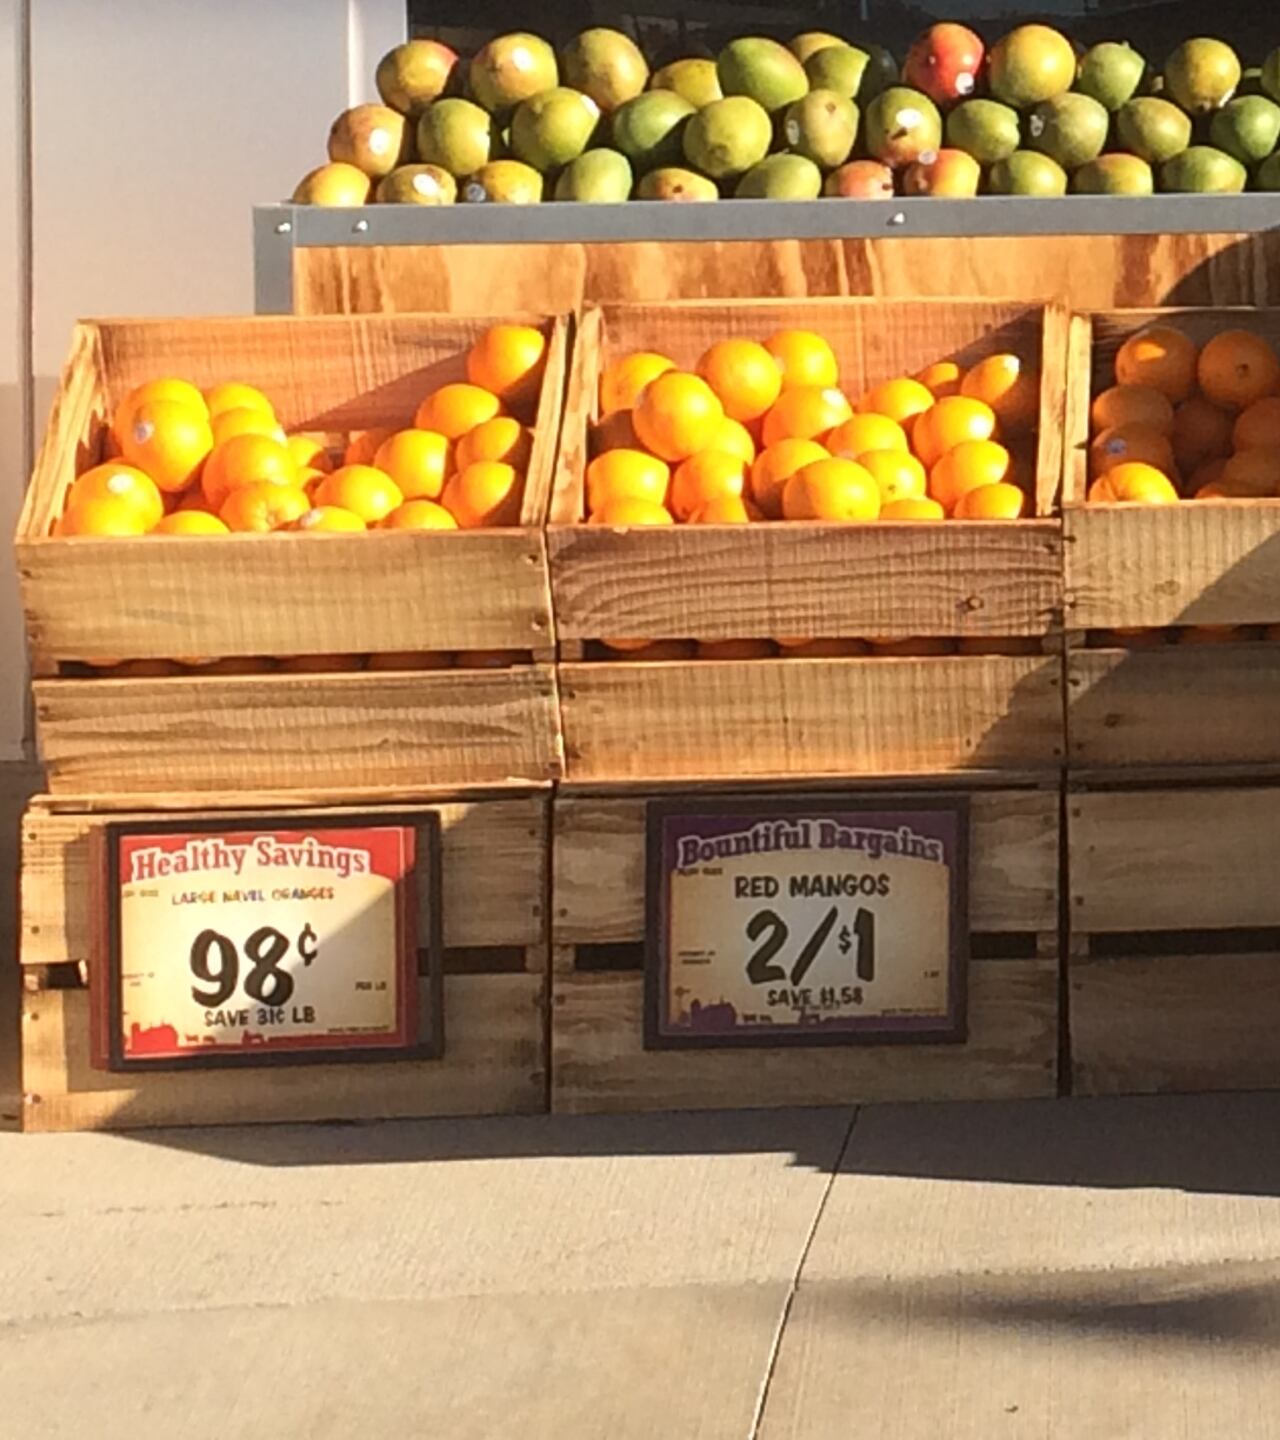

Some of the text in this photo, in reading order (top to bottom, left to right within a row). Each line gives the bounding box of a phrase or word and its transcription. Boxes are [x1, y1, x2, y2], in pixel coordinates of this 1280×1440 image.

[681, 821, 941, 866] Bountiful Bargains
[135, 840, 367, 880] Healthy Savings
[172, 890, 216, 905] LARGE
[223, 889, 265, 903] NAVEL
[271, 887, 335, 901] ORANGES
[735, 874, 890, 899] RED MANGOS
[746, 906, 875, 987] 2/$1
[190, 923, 318, 1008] 98¢
[767, 987, 864, 1007] SAVE $1.58
[204, 1006, 316, 1028] SAVE 31¢ LB
